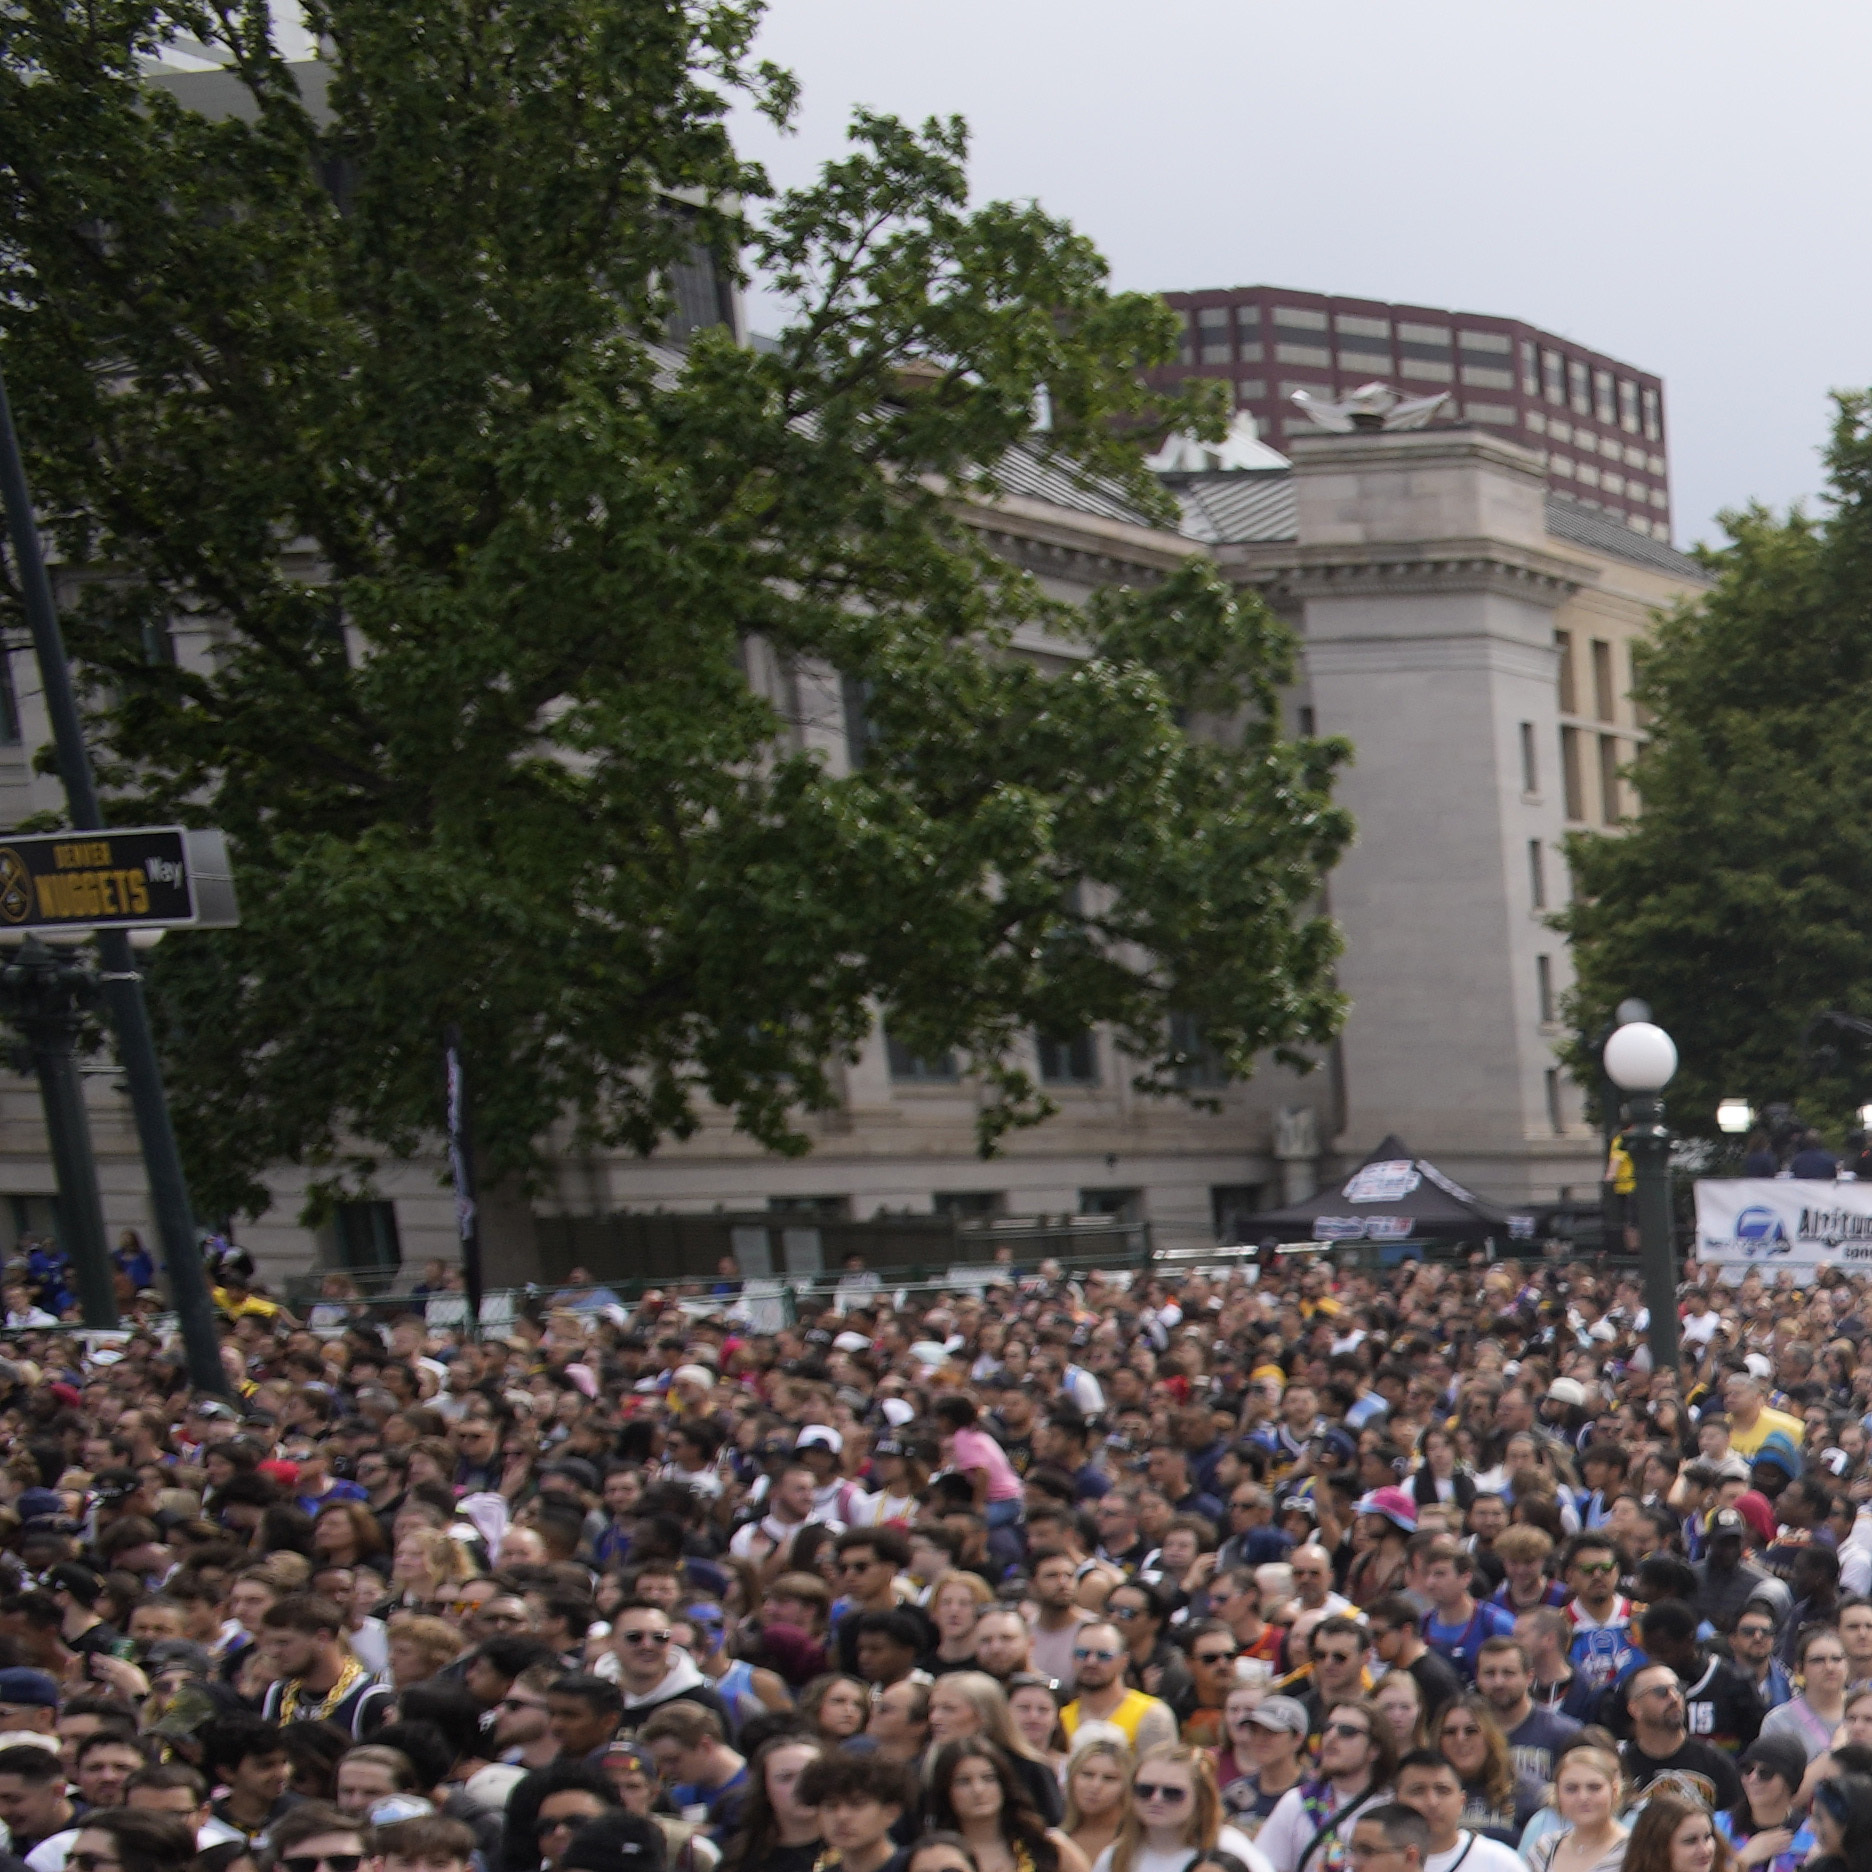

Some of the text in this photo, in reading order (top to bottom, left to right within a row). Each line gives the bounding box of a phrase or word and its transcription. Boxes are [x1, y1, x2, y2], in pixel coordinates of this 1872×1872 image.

[53, 842, 113, 870] DENVER
[34, 855, 184, 918] NUGGETS Way
